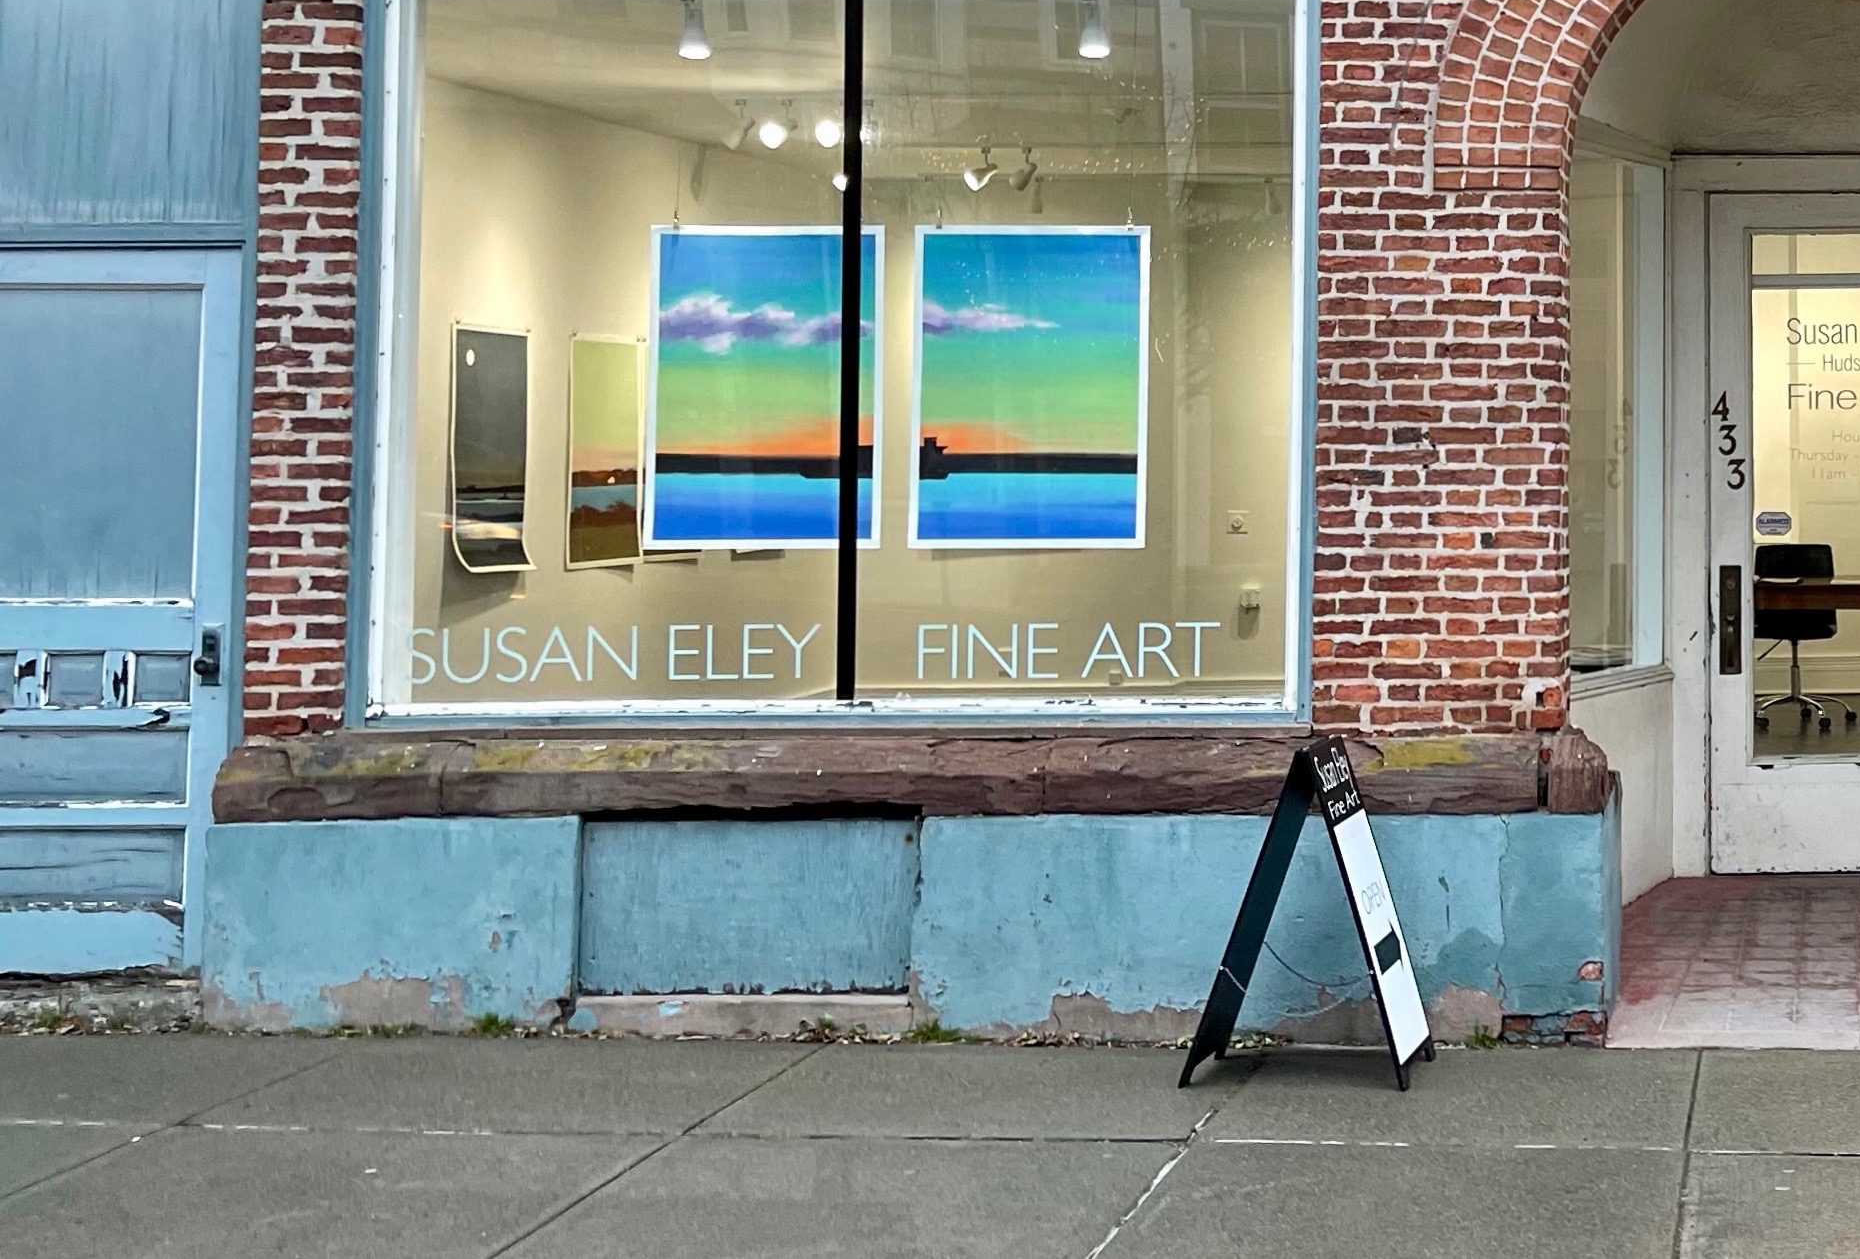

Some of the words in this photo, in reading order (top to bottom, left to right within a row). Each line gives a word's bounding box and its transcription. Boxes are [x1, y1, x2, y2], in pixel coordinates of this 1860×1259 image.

[1786, 317, 1858, 346] Susan
[1788, 384, 1857, 410] Fine
[1711, 390, 1747, 490] 433
[1788, 448, 1850, 463] Thursday
[406, 625, 638, 684] SUSAN
[667, 623, 822, 680] ELEY
[916, 624, 1059, 678] FINE
[1081, 622, 1221, 677] ART
